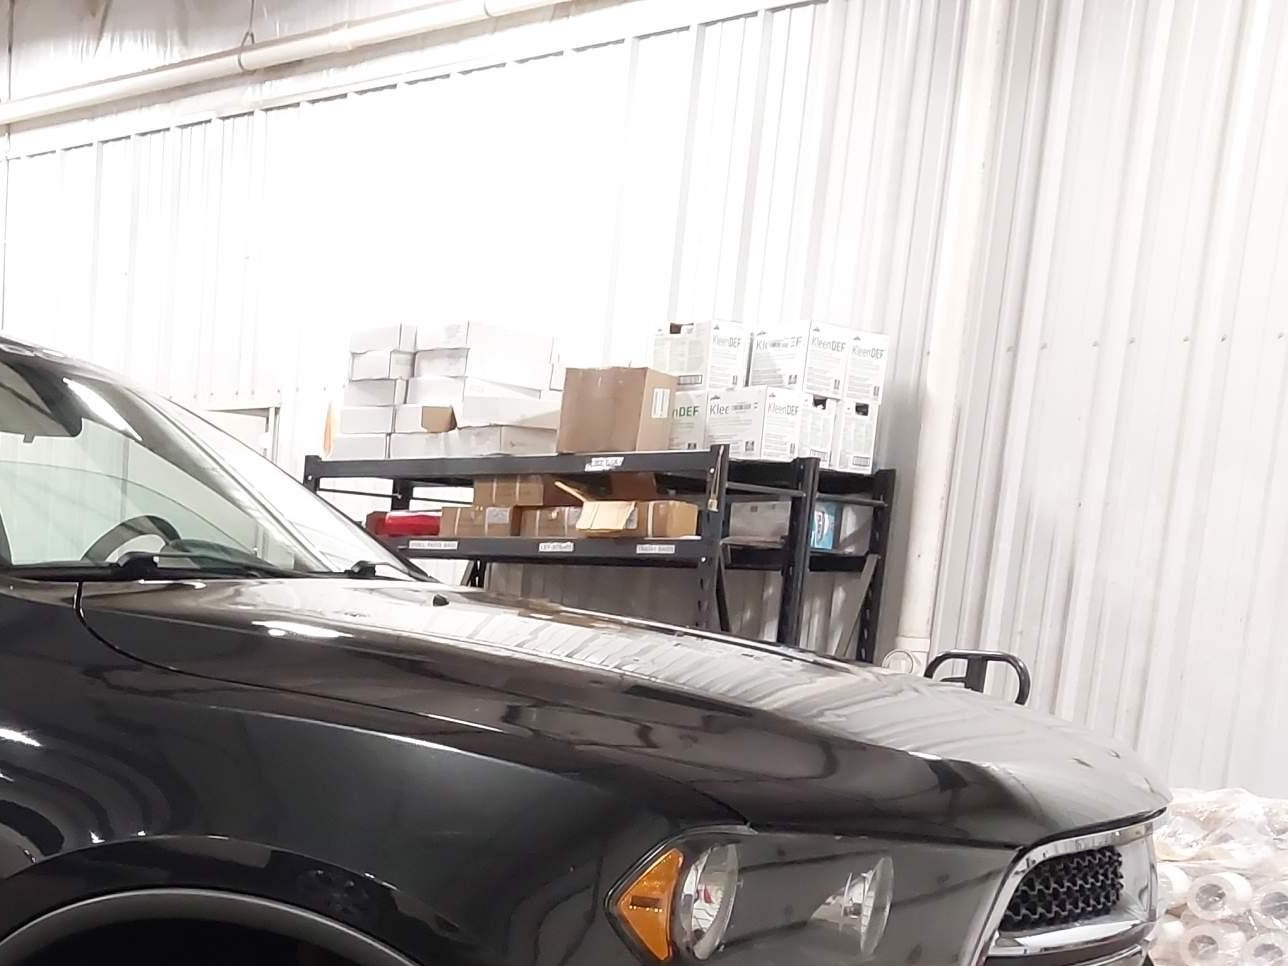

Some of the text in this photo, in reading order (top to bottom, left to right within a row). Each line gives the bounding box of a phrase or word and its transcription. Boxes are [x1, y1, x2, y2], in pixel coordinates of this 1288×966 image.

[812, 336, 846, 353] KleenDEF
[852, 345, 885, 360] KleenDEF
[672, 405, 700, 418] nDEF
[768, 401, 800, 416] KleenDEF
